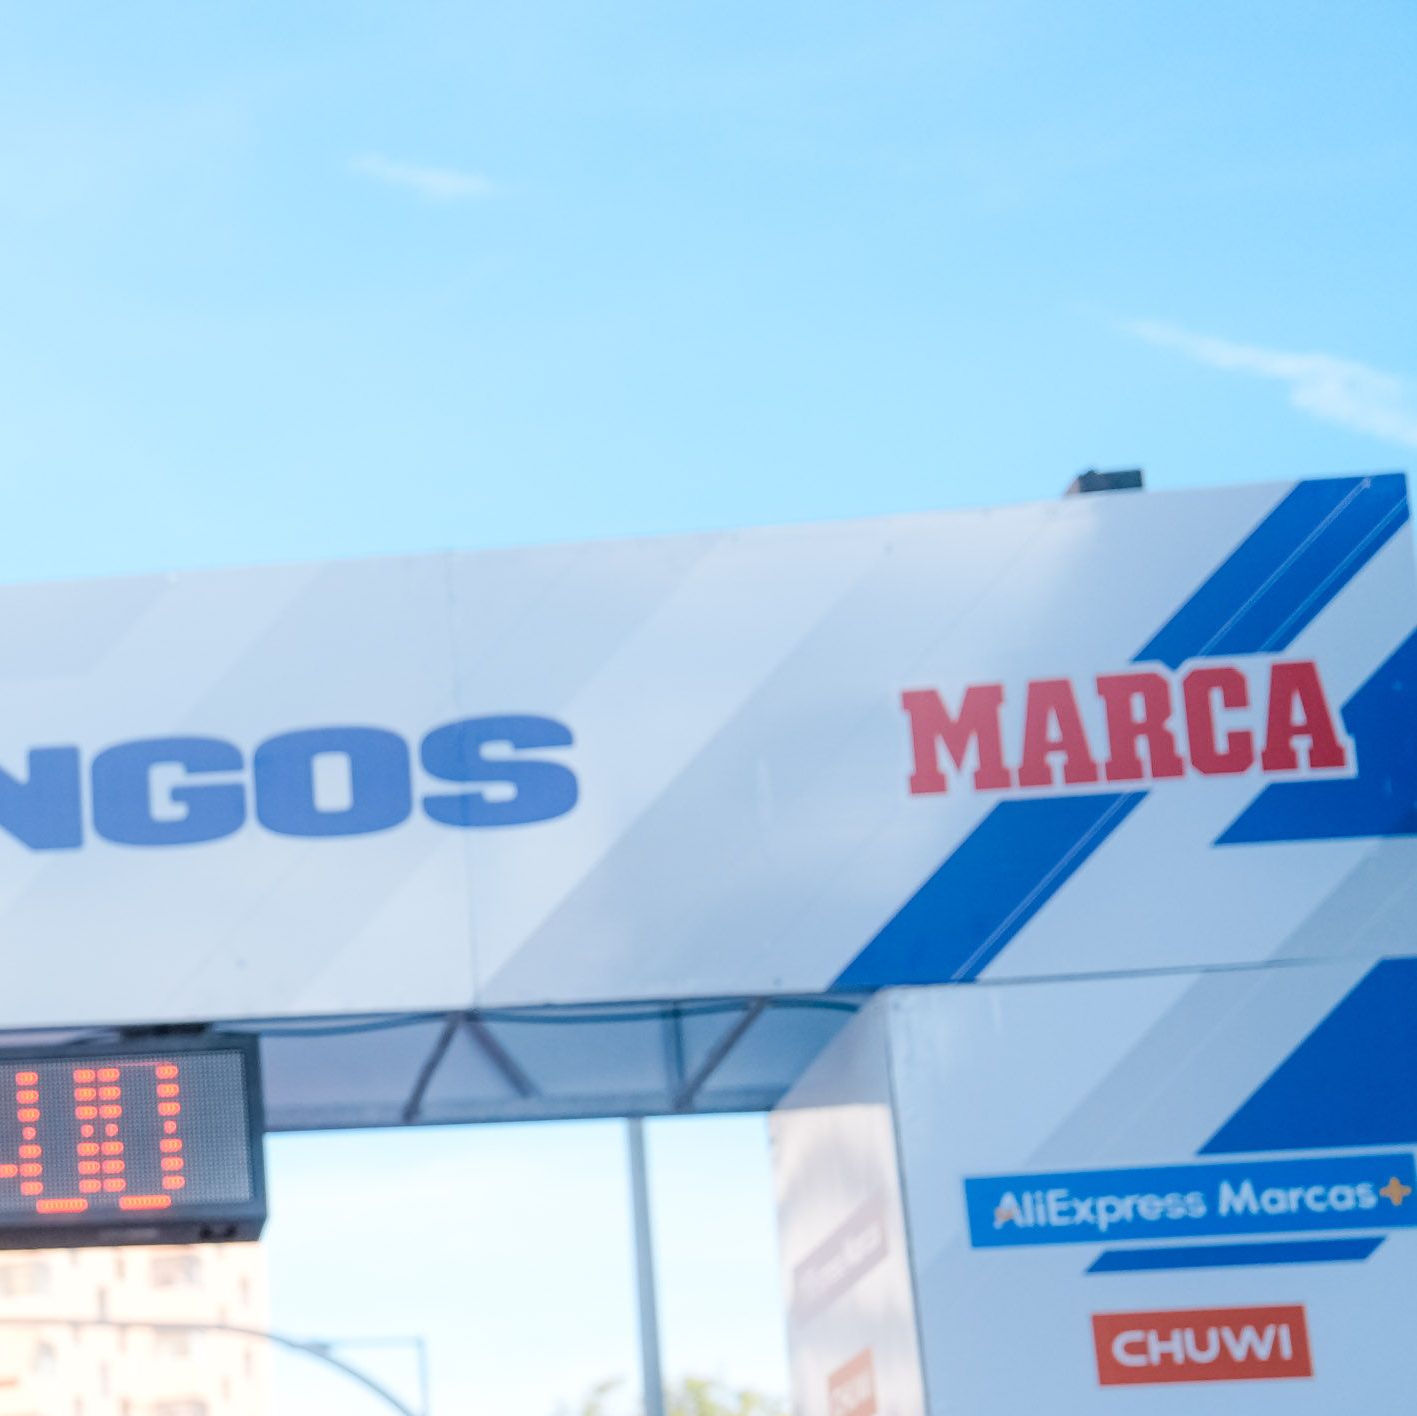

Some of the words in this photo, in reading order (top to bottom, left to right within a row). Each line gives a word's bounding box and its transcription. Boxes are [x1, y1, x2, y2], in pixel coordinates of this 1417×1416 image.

[900, 660, 1350, 796] MARCA
[994, 1189, 1206, 1231] AliExpress
[1111, 1323, 1293, 1367] CHUWI
